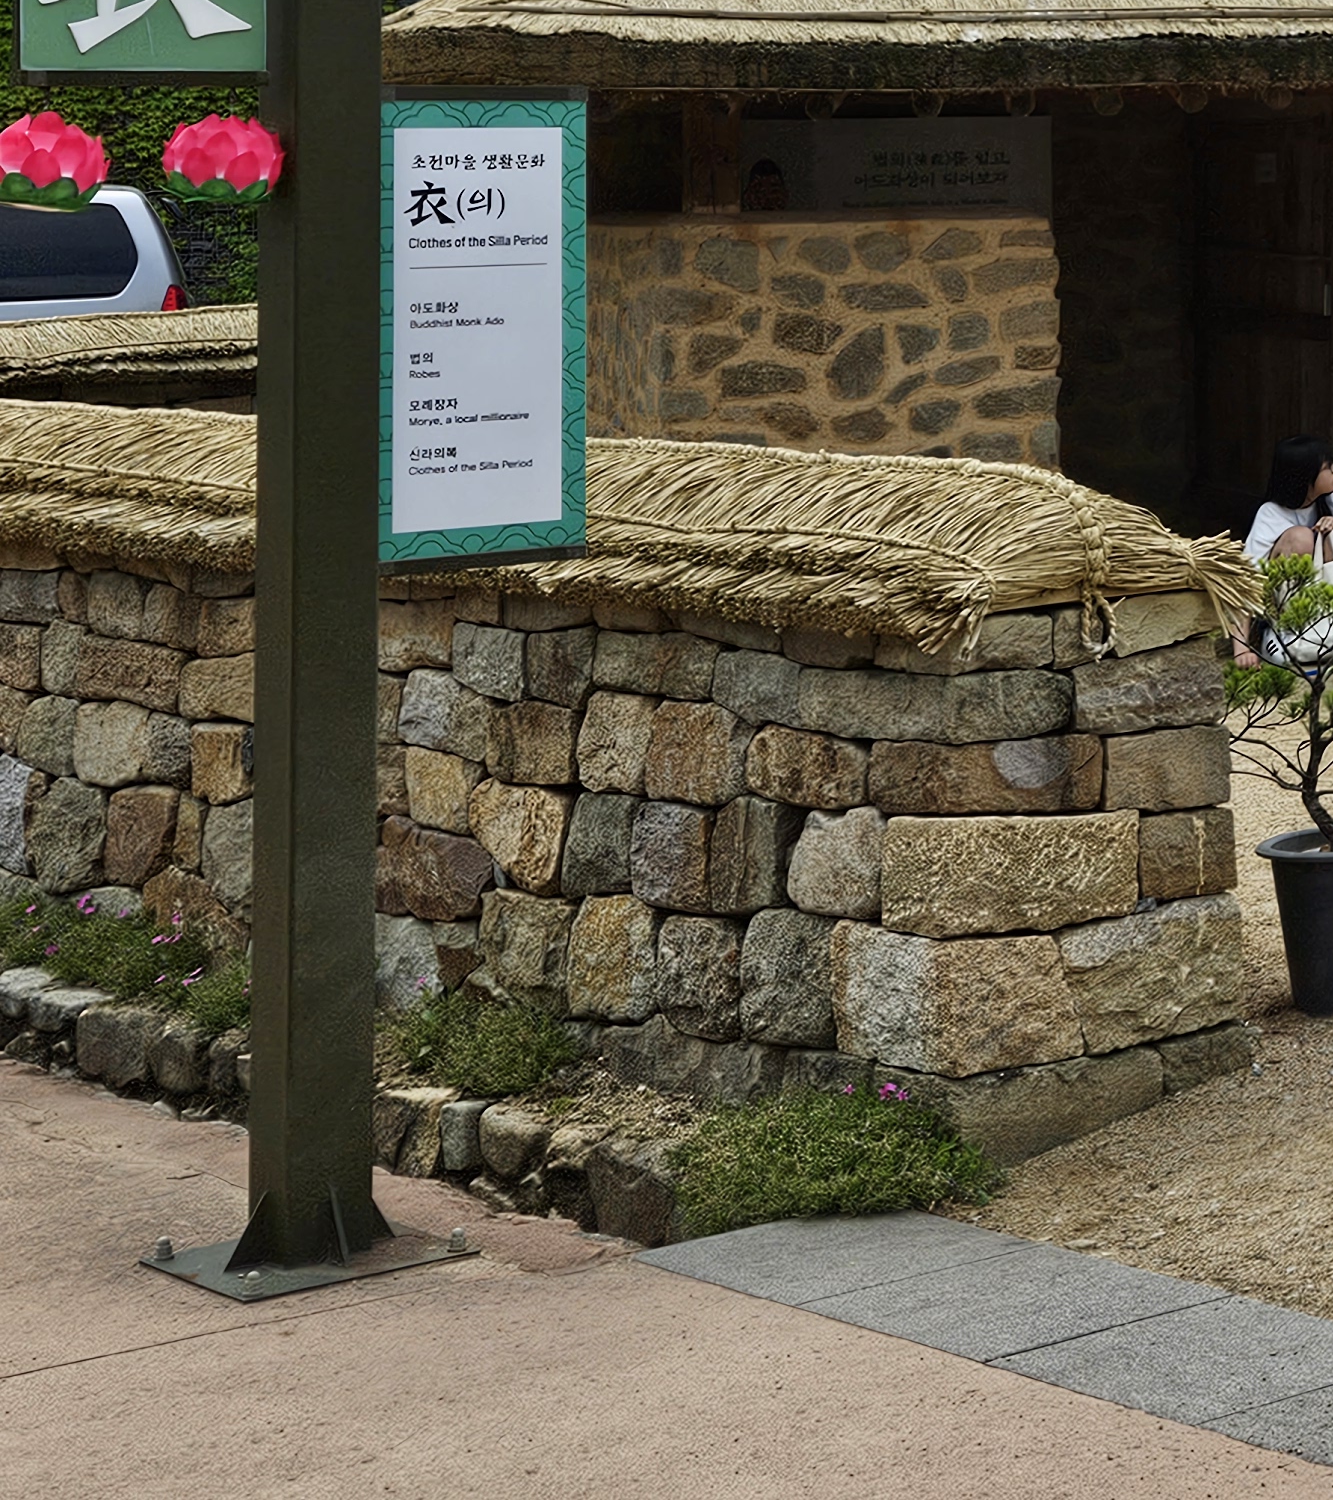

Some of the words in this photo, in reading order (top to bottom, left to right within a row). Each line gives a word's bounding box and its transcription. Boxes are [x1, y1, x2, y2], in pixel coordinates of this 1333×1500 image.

[411, 154, 477, 170] 초전마을
[482, 153, 546, 170] 생활문화
[403, 180, 506, 227] 衣(의)
[408, 237, 451, 249] Clothes
[454, 236, 466, 248] of
[468, 236, 486, 247] the
[488, 235, 511, 247] Silla
[513, 234, 549, 246] Period
[409, 301, 459, 314] 아도화상
[410, 319, 453, 329] Buddhist
[456, 317, 482, 327] Monk
[484, 316, 505, 326] Ado
[409, 352, 434, 365] 법의
[409, 370, 441, 379] Robes
[454, 414, 478, 423] local
[480, 412, 530, 422] millionaire
[409, 446, 457, 461] 신라의복
[408, 466, 446, 476] Clothes
[448, 464, 458, 473] of
[461, 463, 477, 472] the
[479, 461, 500, 471] Silla
[502, 459, 533, 469] Period
